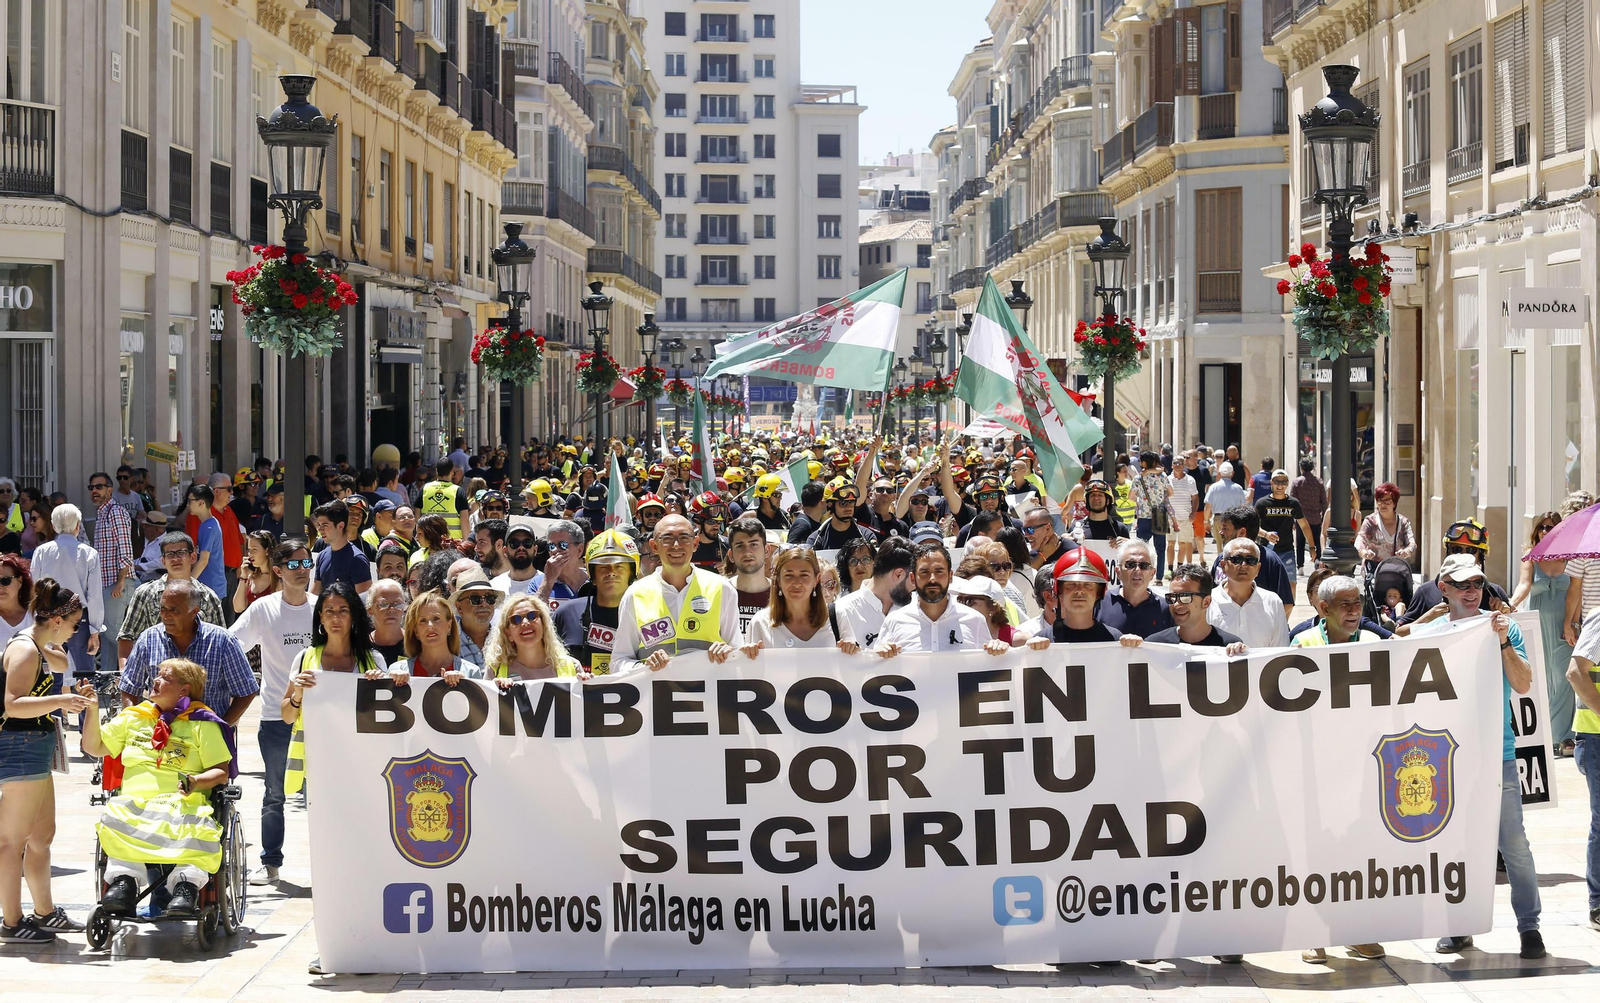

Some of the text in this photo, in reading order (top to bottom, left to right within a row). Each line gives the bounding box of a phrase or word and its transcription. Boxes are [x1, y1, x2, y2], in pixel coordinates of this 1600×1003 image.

[1518, 302, 1576, 312] PANDORA
[994, 402, 1053, 446] BOMBERO
[590, 628, 614, 642] NO
[356, 648, 1458, 738] BOMBEROS EN LUCHA
[404, 763, 454, 778] MALAGA
[724, 734, 1096, 805] POR TU
[1394, 738, 1438, 754] MALAGA
[398, 826, 424, 860] CUERPO
[454, 785, 464, 845] BOMBEROS
[619, 801, 1208, 874] SEGURIDAD
[447, 882, 876, 945] Bomberos Málaga en Lucha
[1056, 852, 1467, 923] @encierrobombmlg
